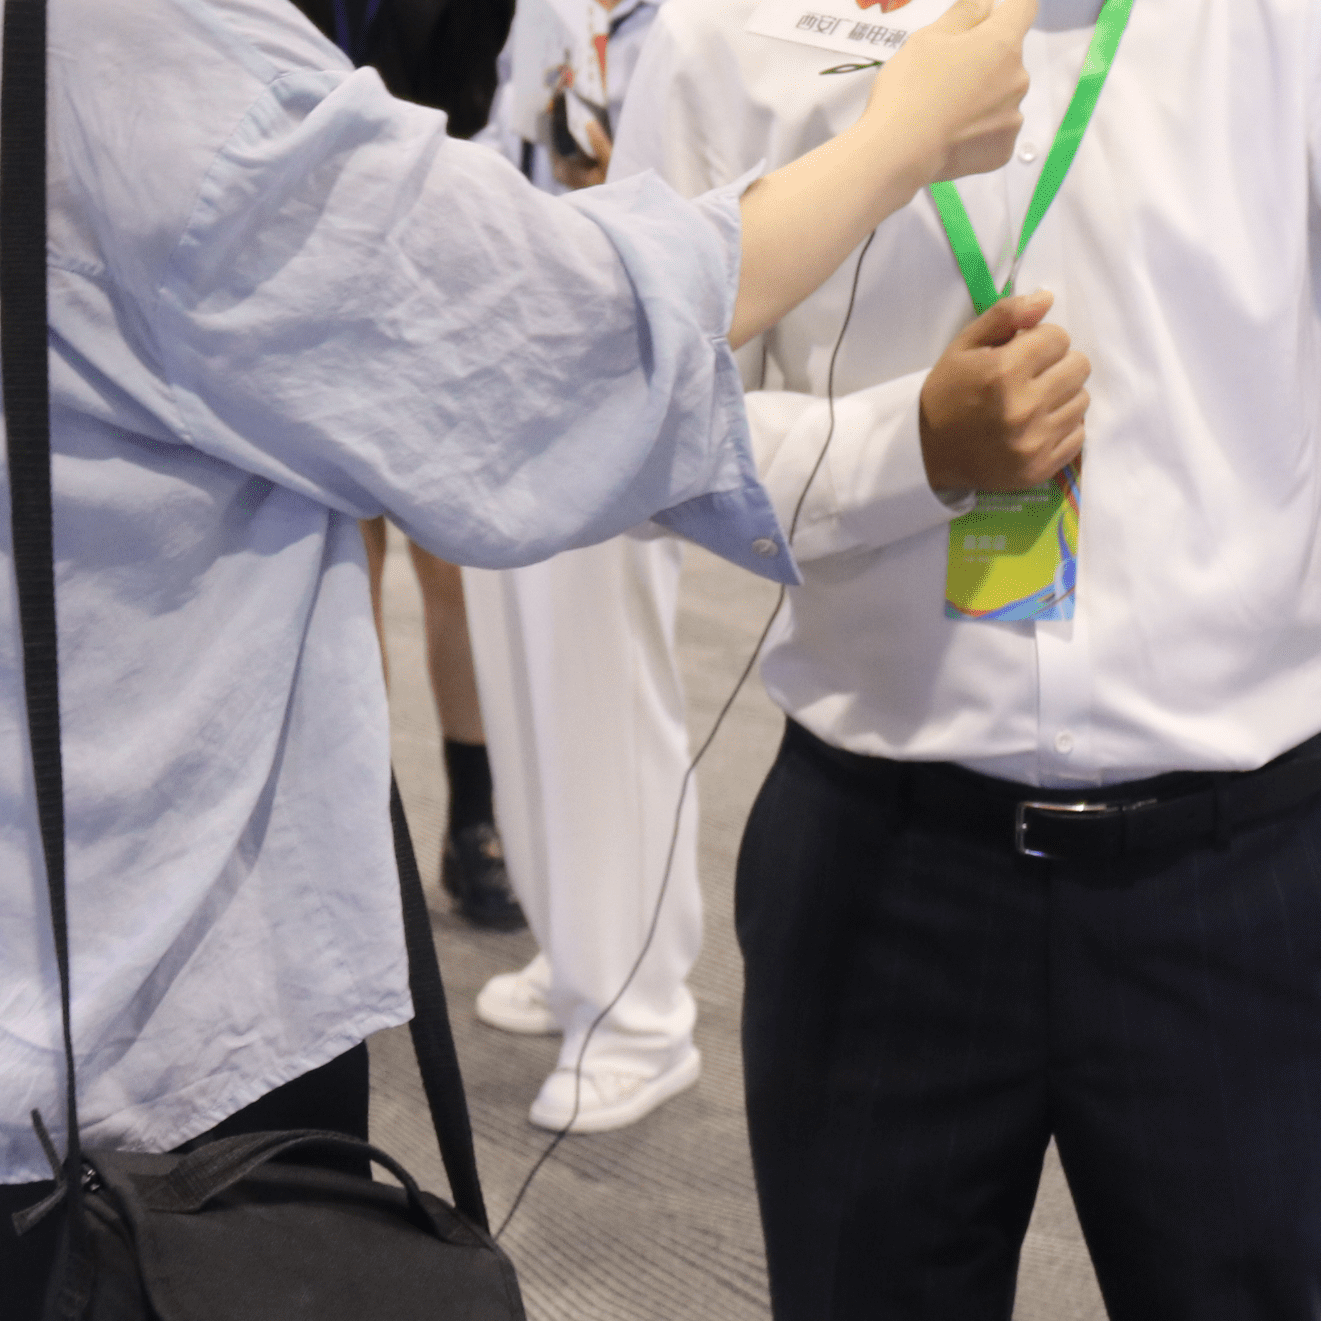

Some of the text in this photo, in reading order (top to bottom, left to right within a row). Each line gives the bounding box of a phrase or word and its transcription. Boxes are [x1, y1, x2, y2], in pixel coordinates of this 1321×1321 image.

[795, 13, 909, 49] 西安广播电视
